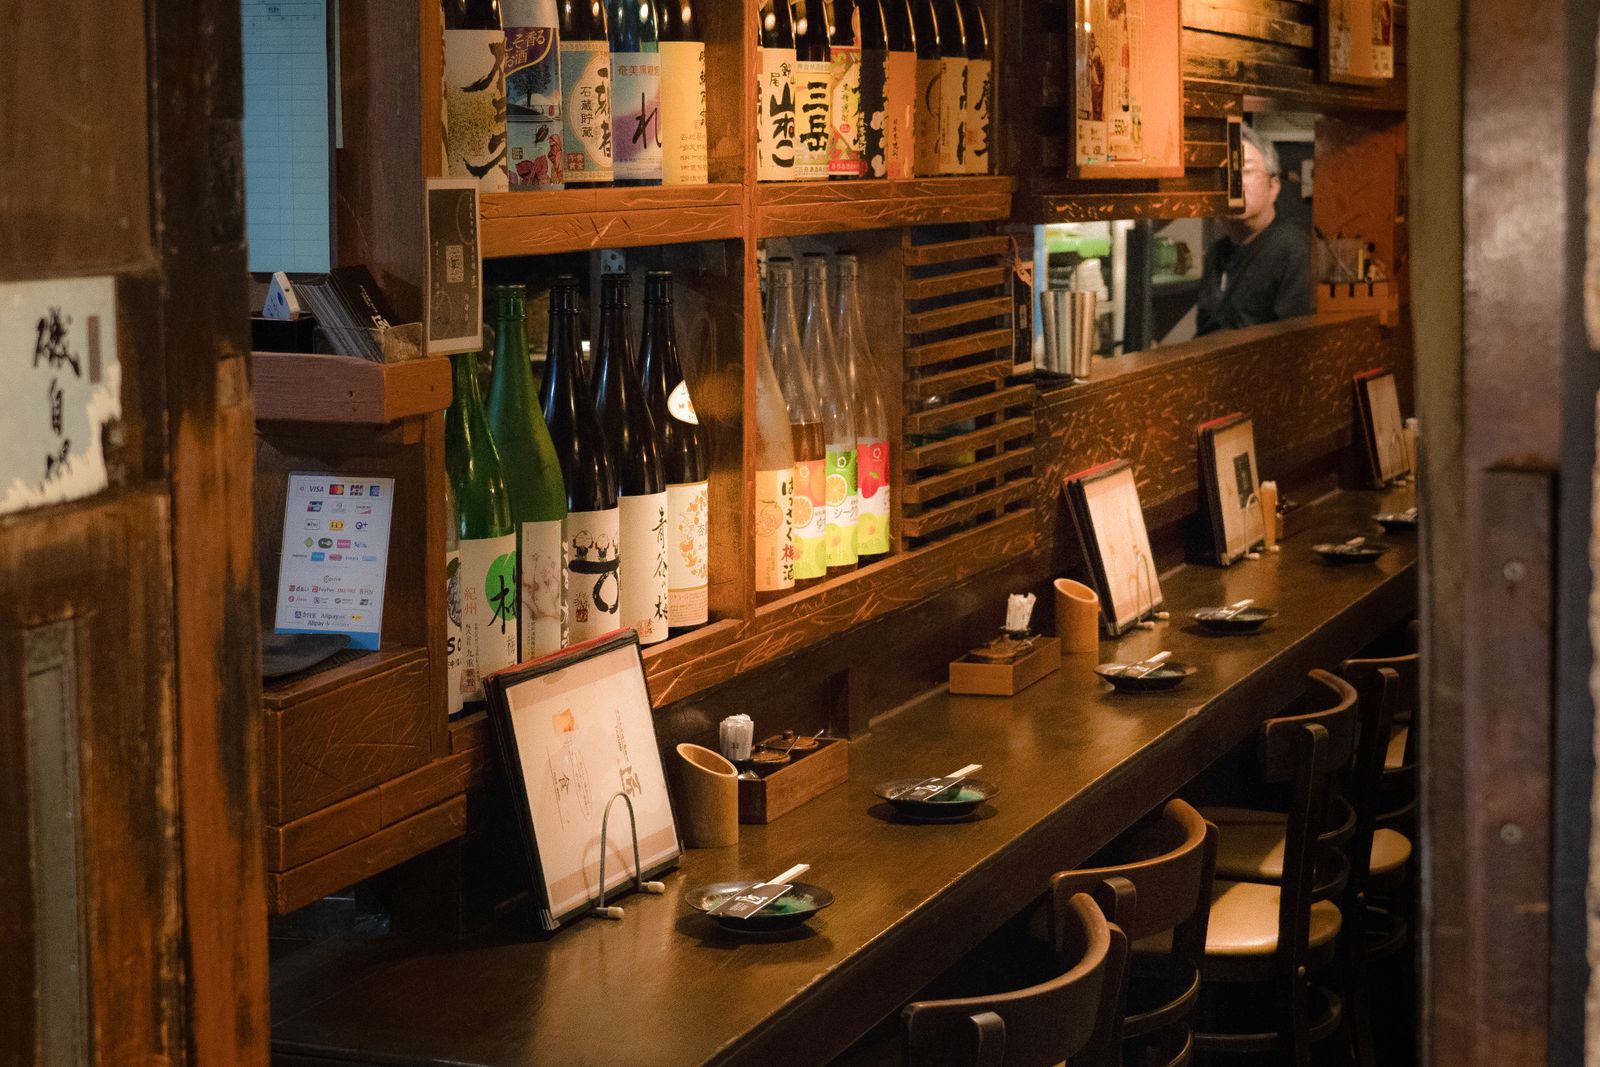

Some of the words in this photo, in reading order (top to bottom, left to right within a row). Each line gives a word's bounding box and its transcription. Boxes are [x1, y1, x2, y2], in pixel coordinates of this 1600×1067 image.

[580, 86, 595, 138] 石蔵貯蔵
[769, 82, 796, 168] 山ねこ
[799, 81, 830, 152] 三岳
[309, 485, 325, 493] VISA
[463, 586, 478, 616] 紀州
